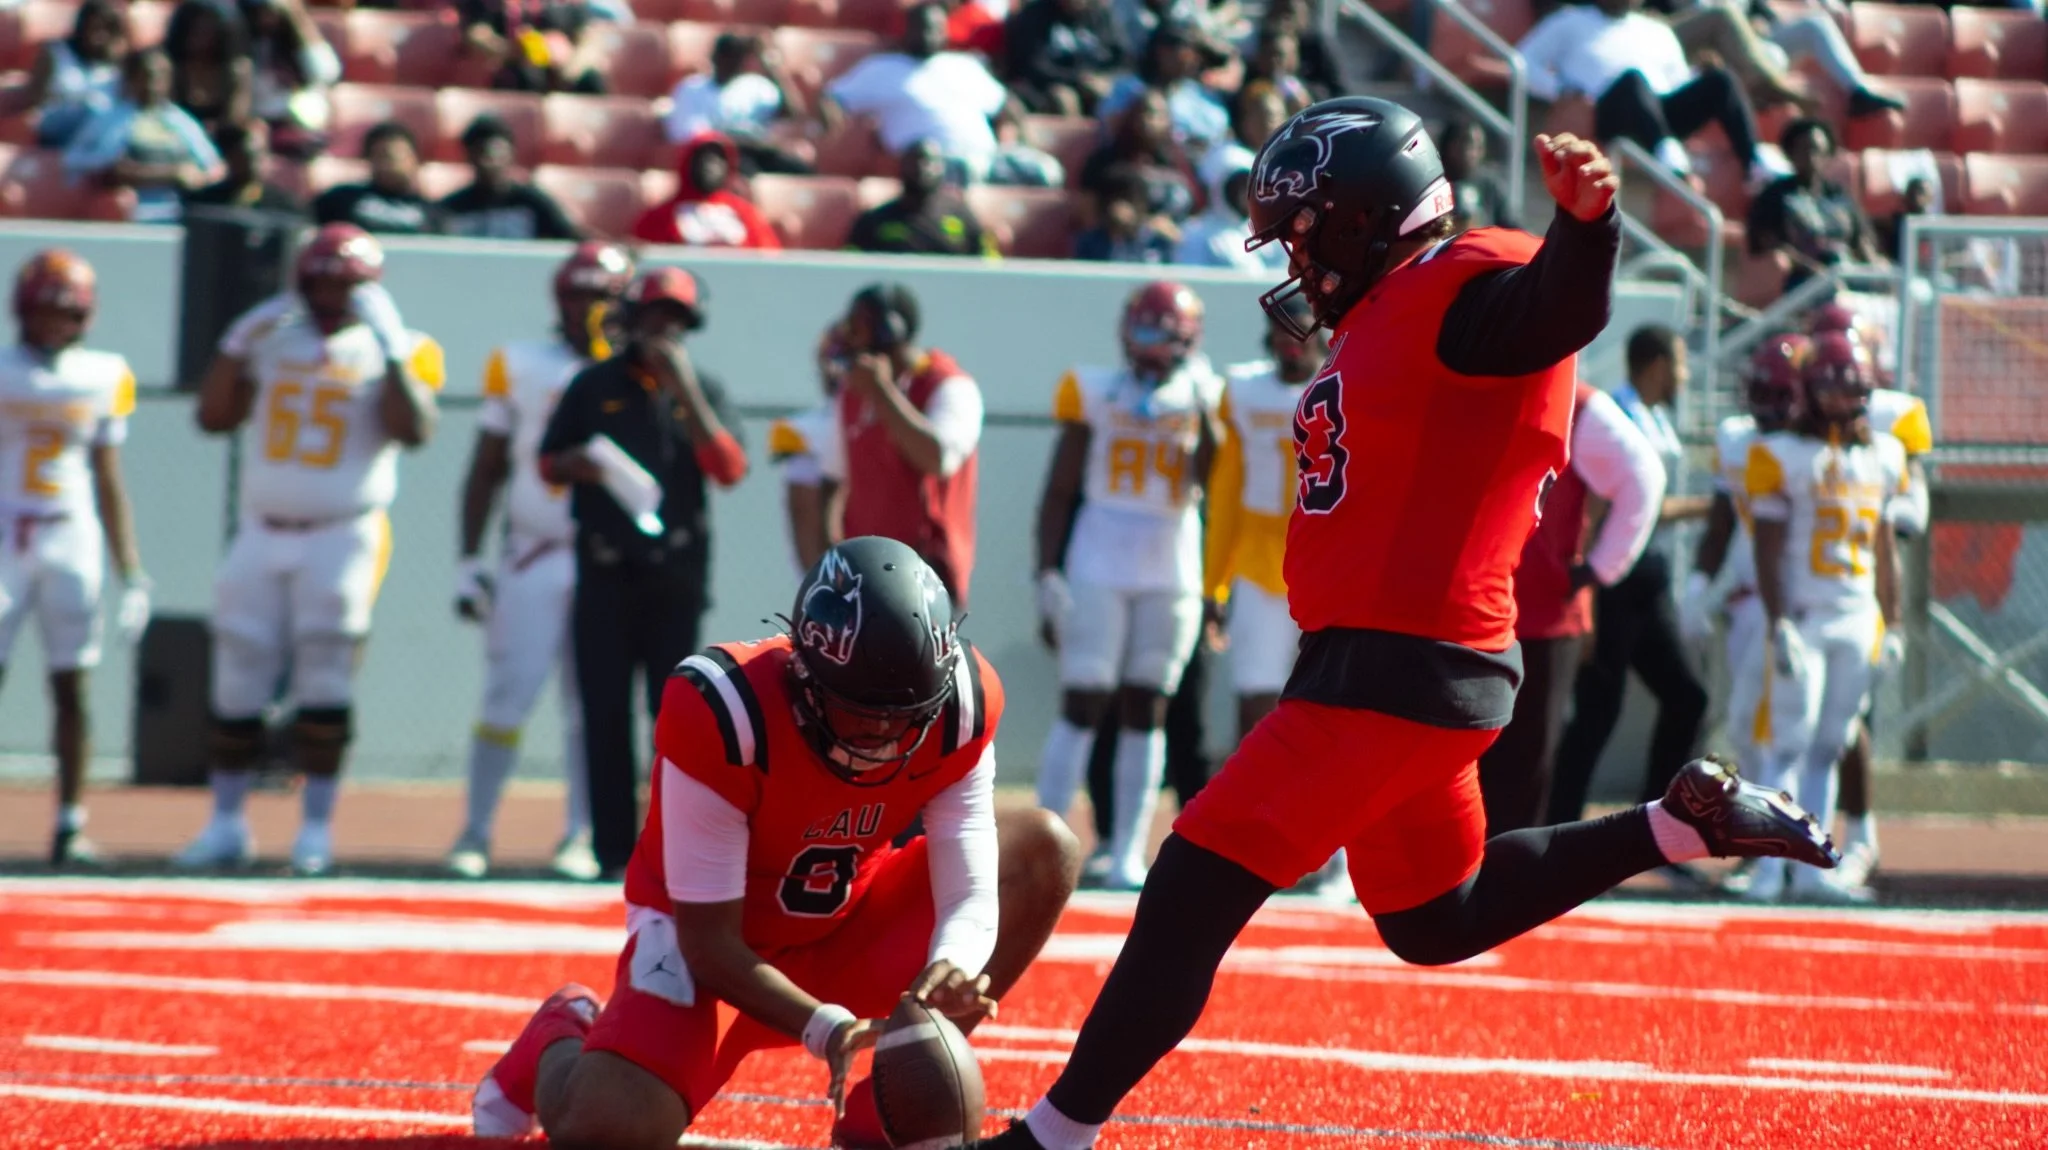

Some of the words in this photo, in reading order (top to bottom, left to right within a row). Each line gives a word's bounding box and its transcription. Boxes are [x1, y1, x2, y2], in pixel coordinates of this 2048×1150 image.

[23, 426, 64, 495] 2
[265, 381, 349, 469] 65
[1293, 371, 1350, 515] 3
[801, 802, 885, 840] CAU
